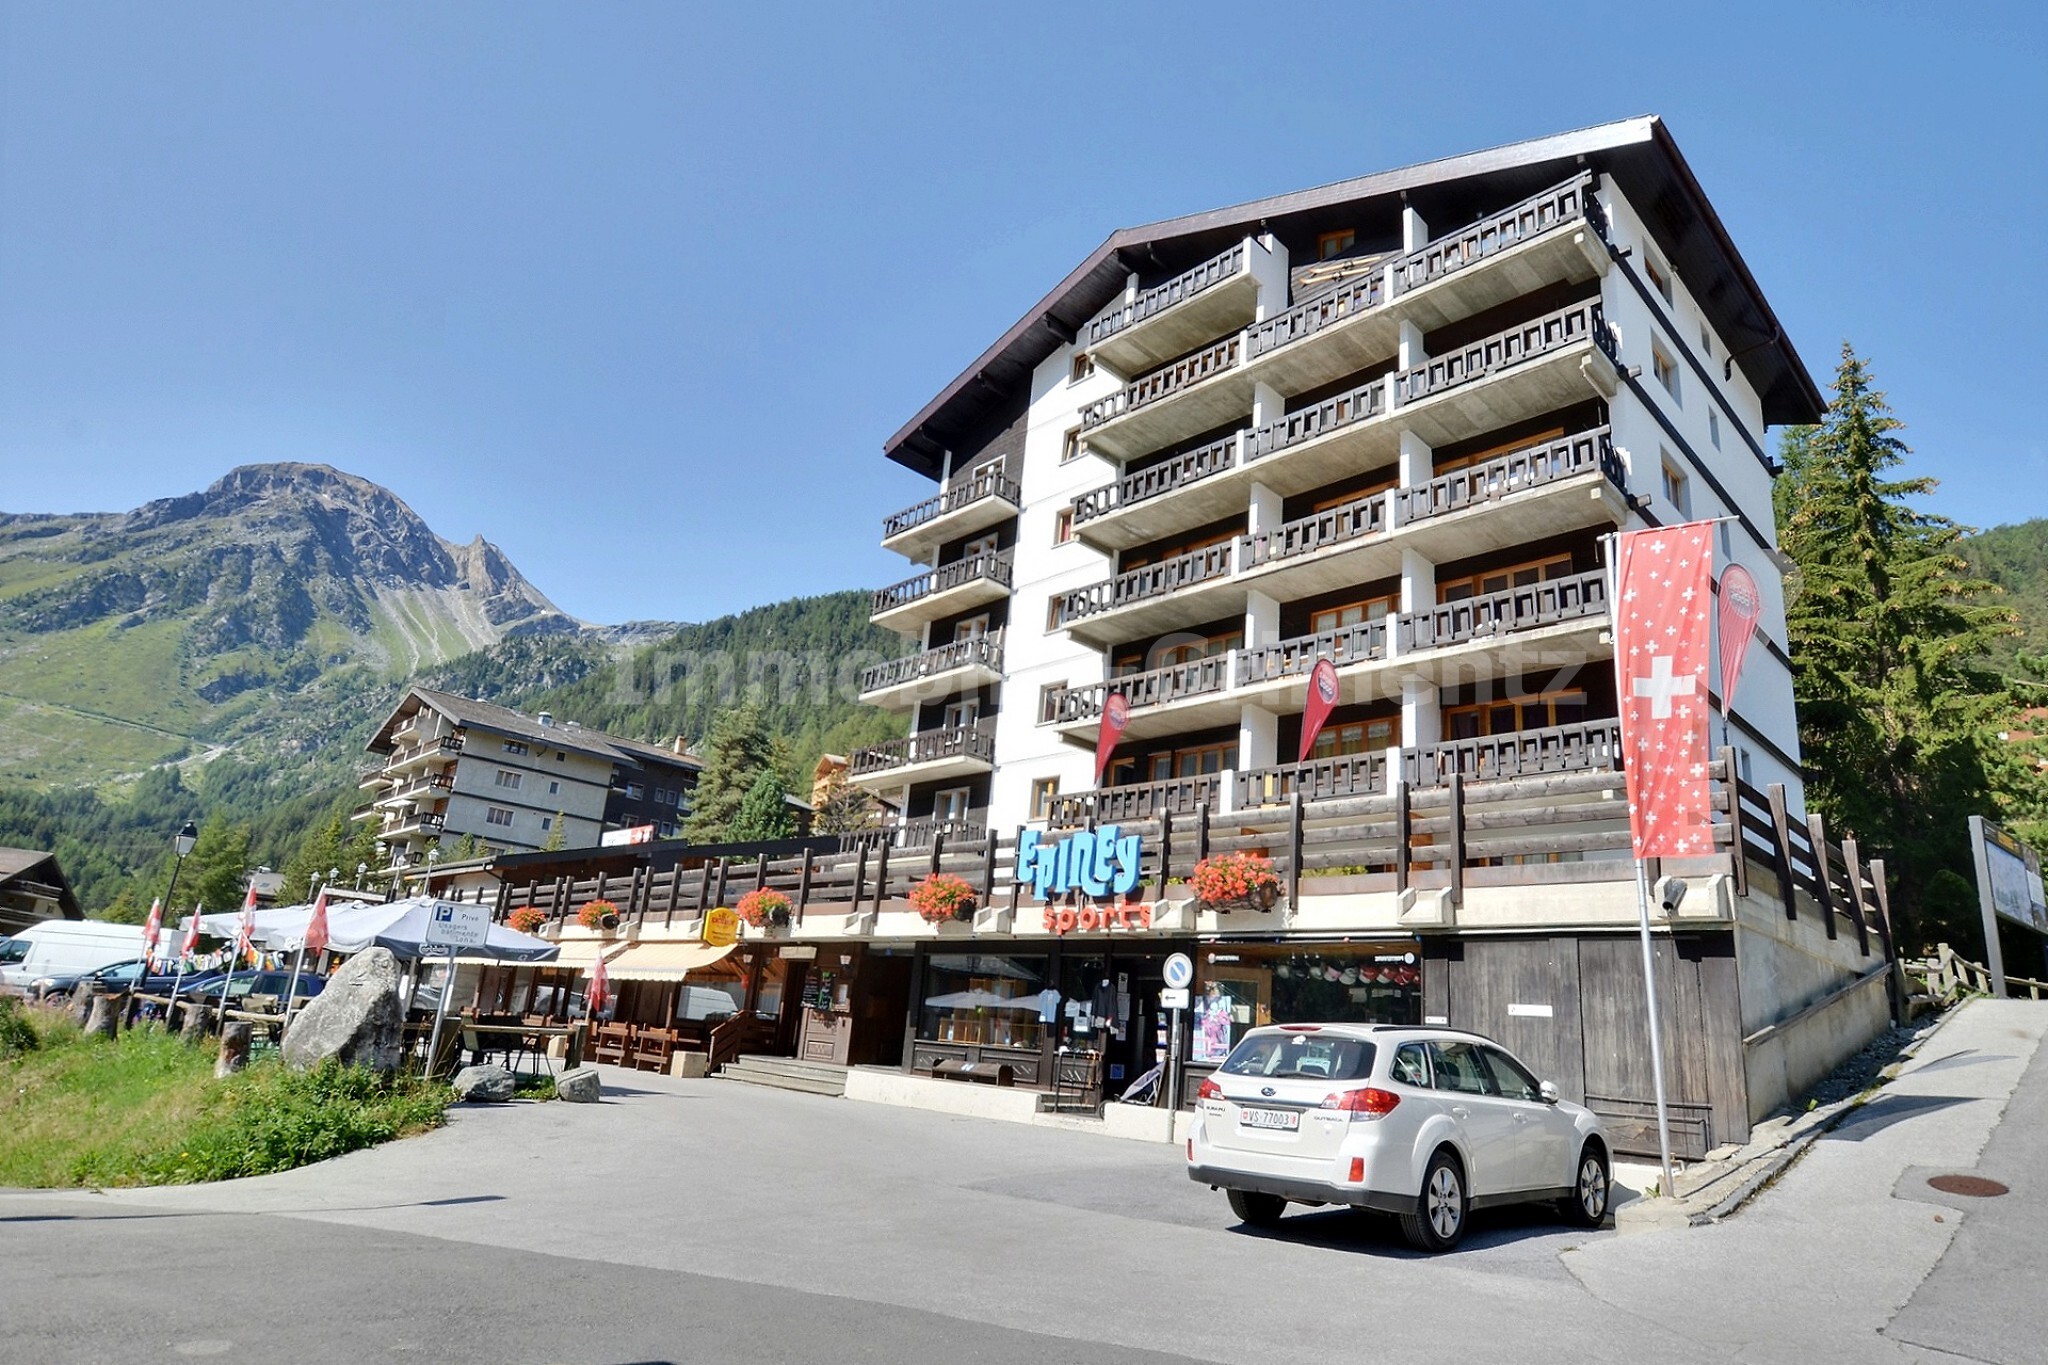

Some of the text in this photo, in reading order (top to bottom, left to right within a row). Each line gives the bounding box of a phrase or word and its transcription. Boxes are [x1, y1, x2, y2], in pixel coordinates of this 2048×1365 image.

[1042, 898, 1152, 936] sports
[1248, 1110, 1290, 1125] VS 77003
